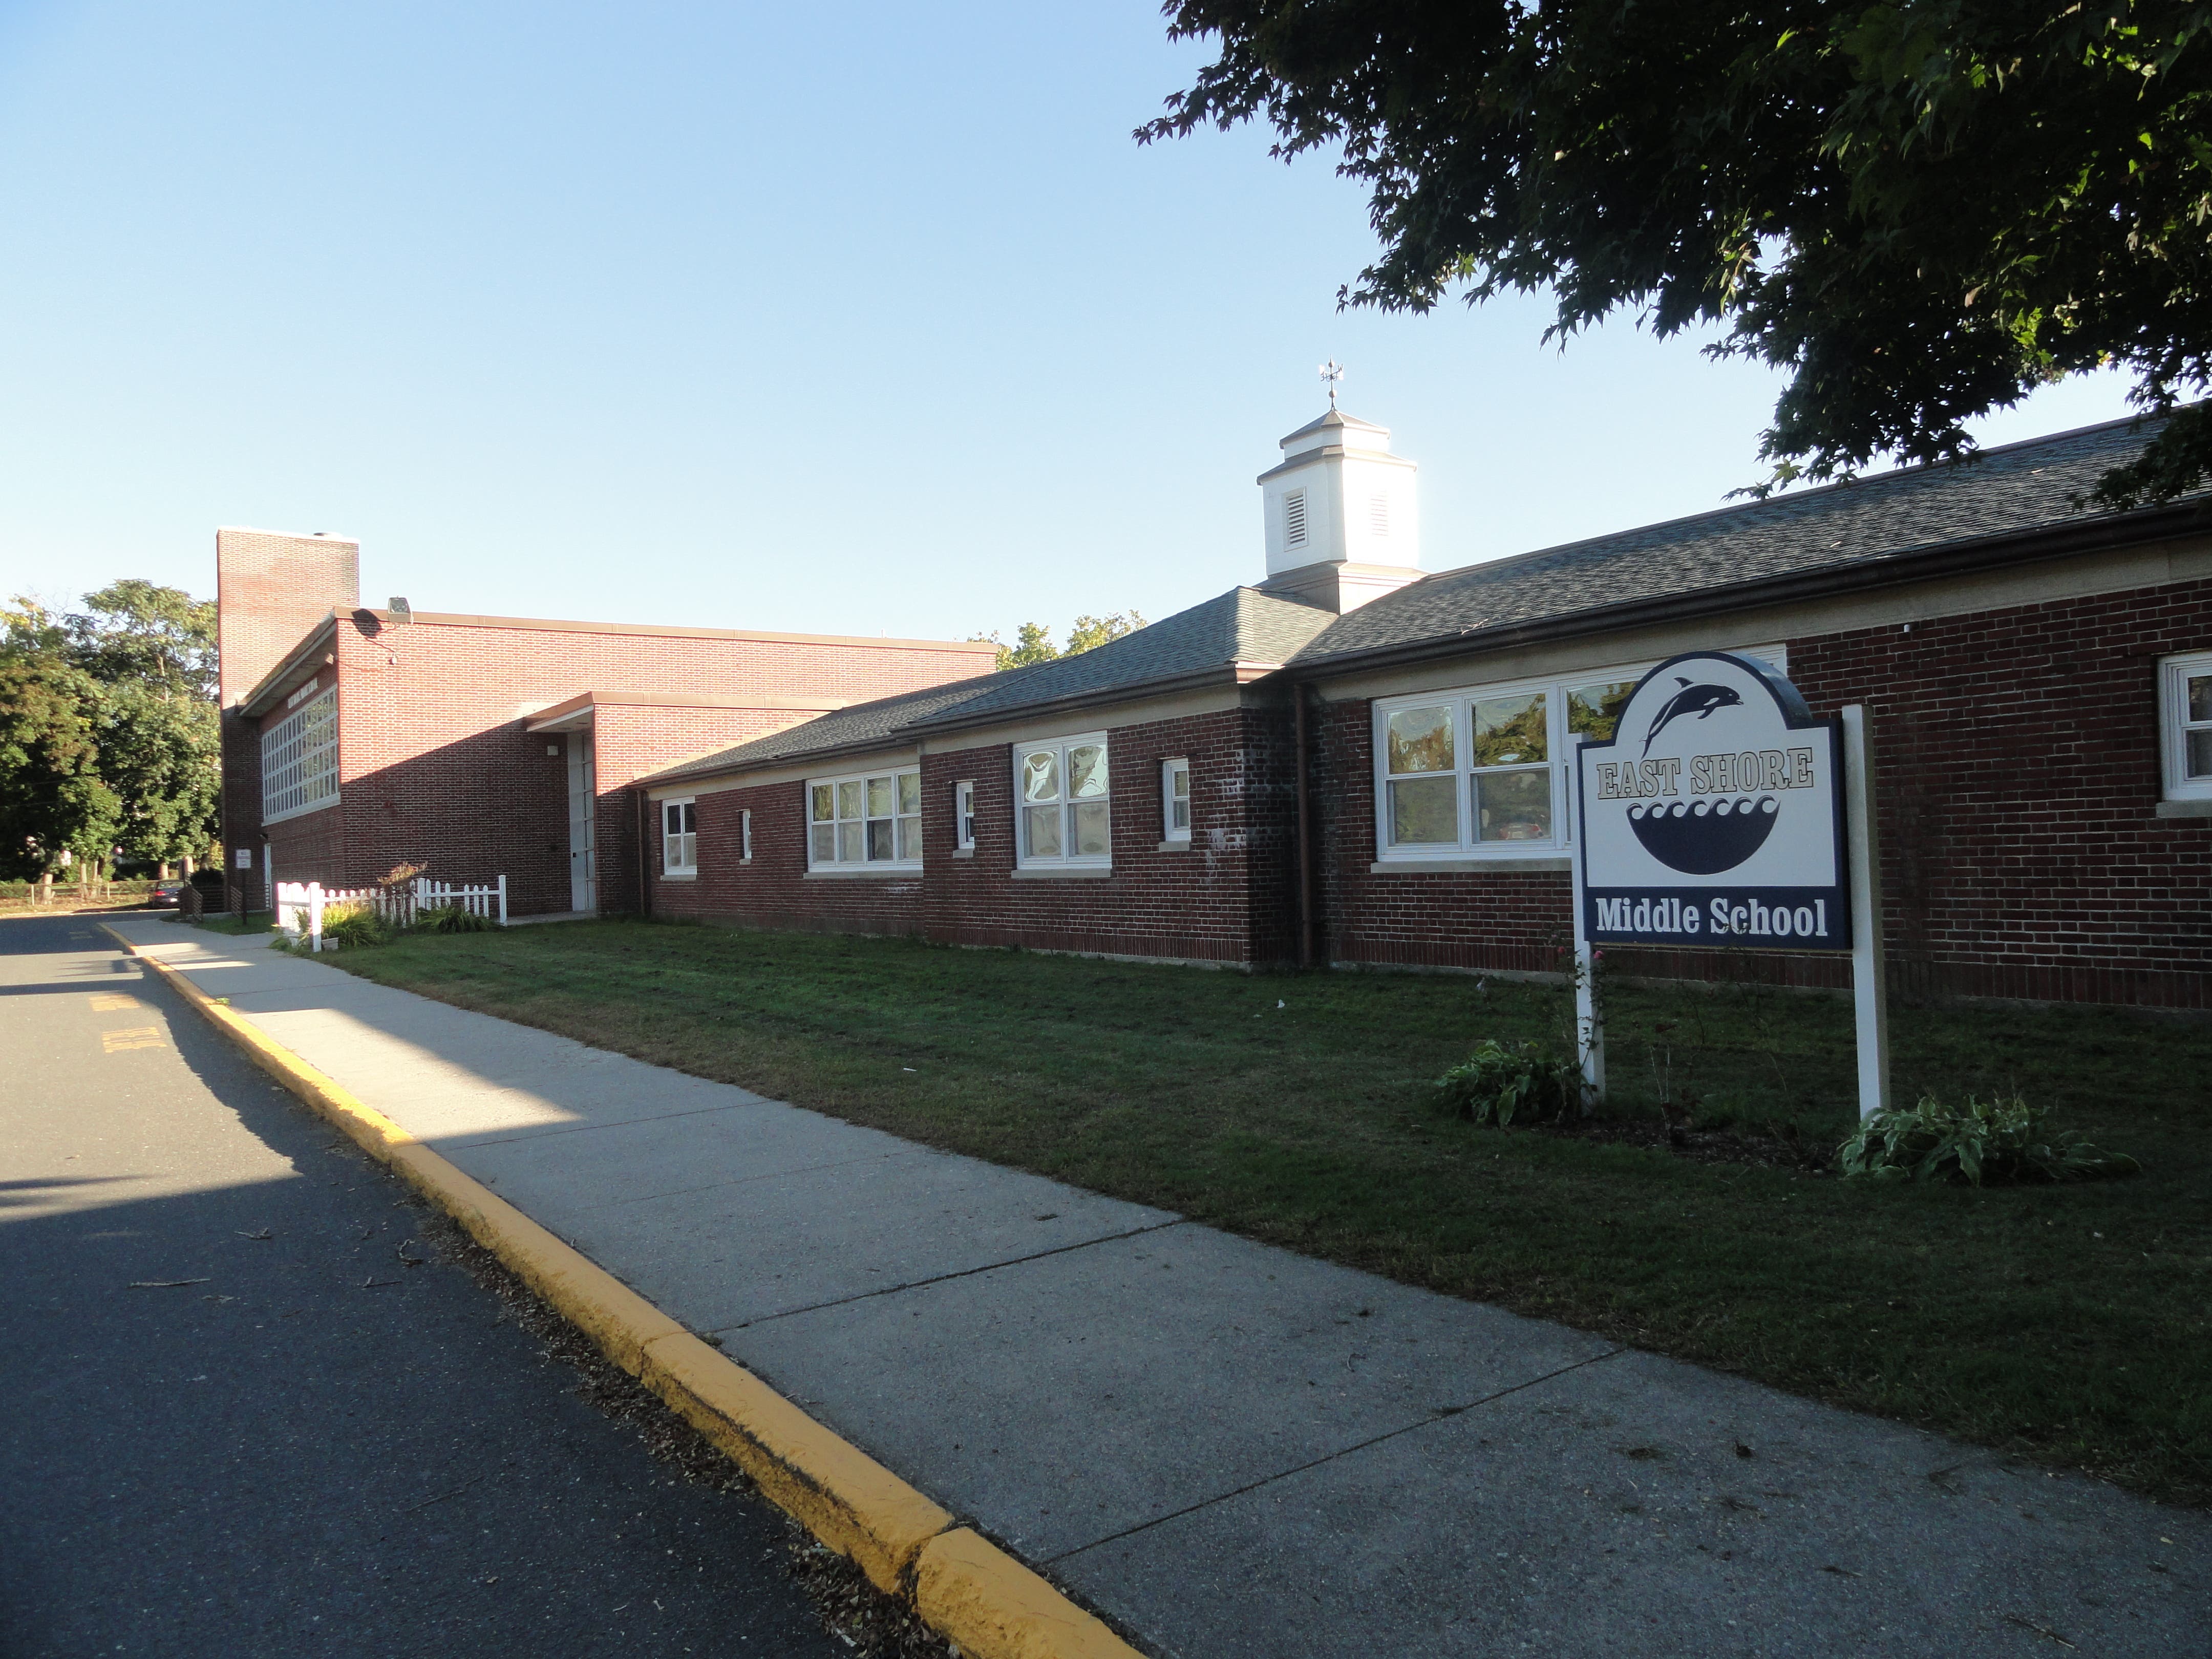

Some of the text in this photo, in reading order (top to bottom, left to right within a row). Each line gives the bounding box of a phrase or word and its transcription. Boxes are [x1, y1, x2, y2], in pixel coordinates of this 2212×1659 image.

[1597, 747, 1814, 800] EAST SHORE
[1596, 897, 1828, 937] Middle School
